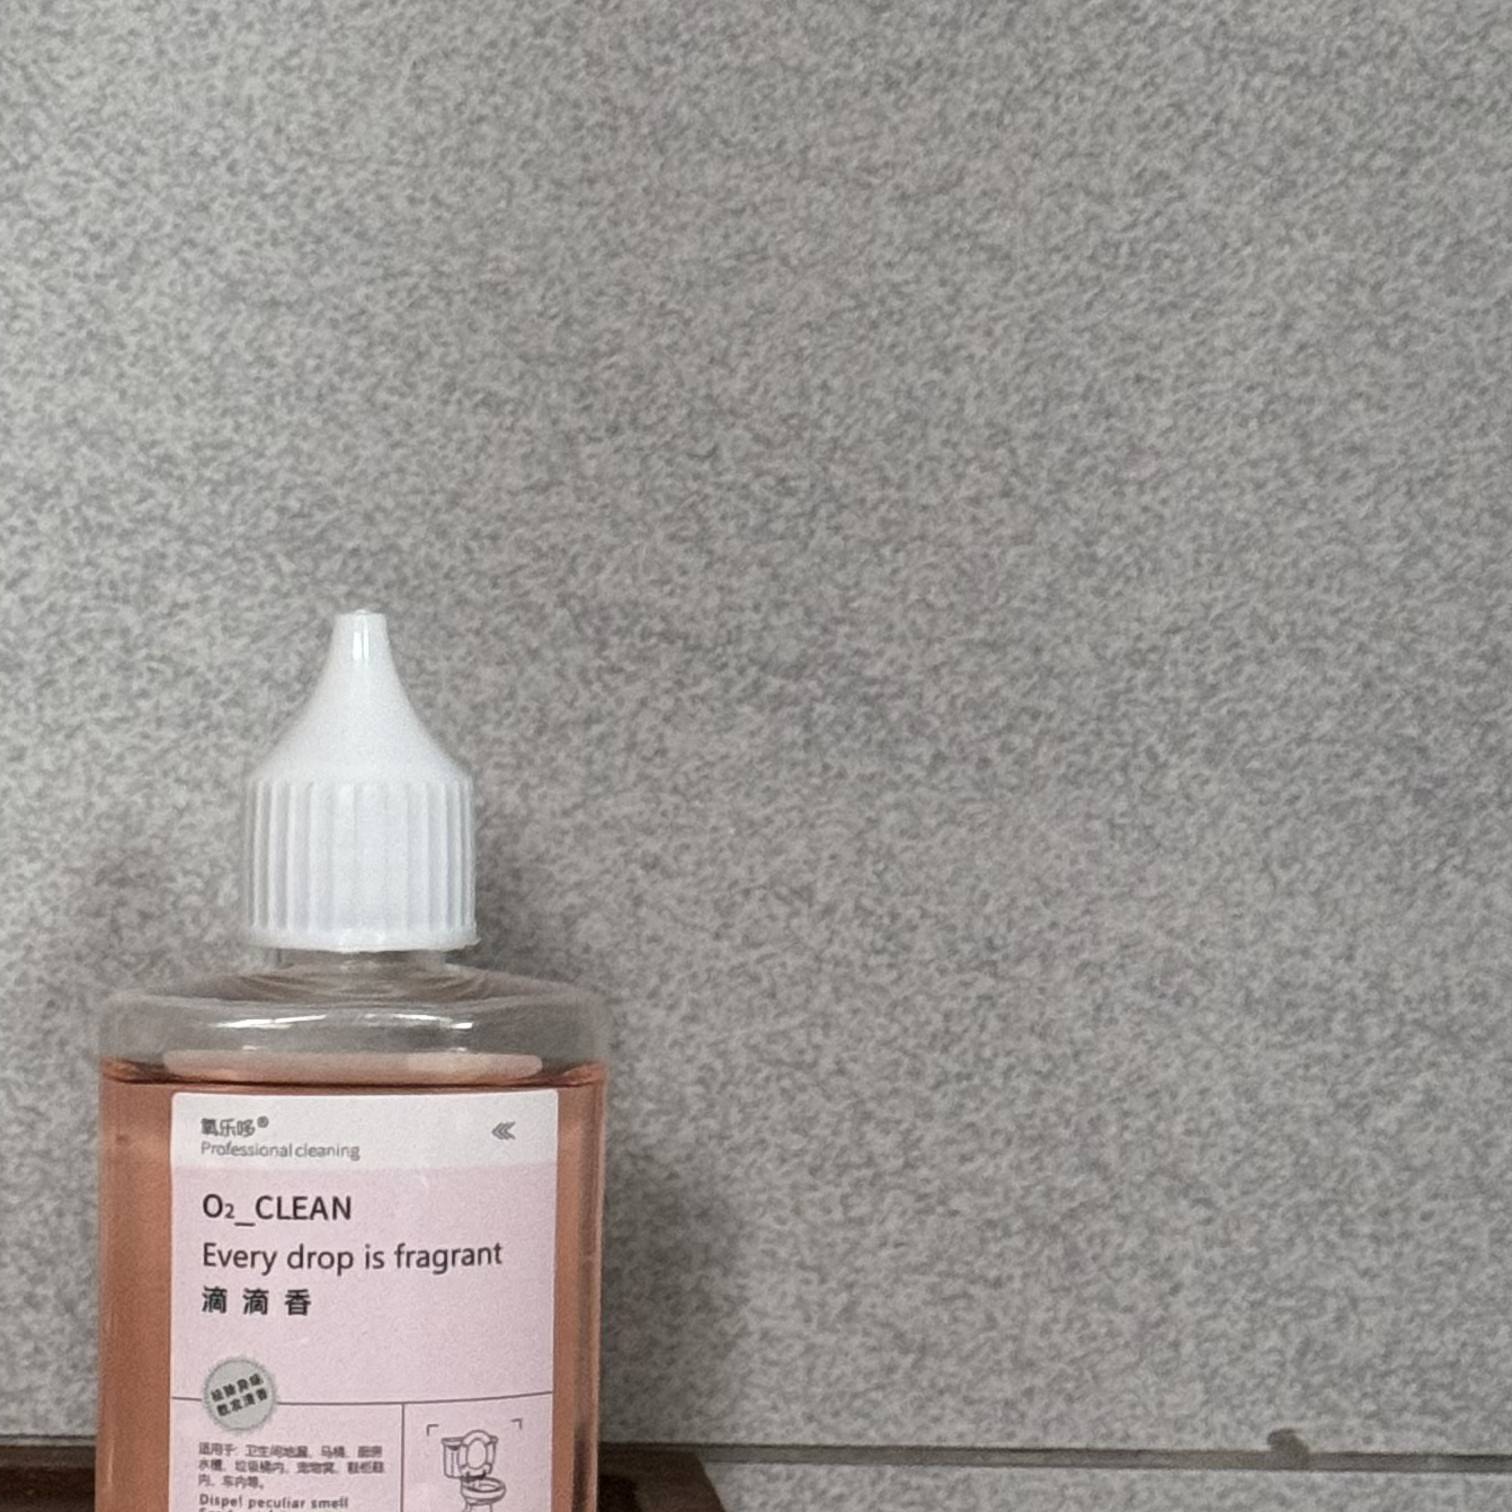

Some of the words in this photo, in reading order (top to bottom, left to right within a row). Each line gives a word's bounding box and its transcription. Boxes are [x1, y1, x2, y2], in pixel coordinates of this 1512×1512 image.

[201, 1140, 293, 1157] Professional
[295, 1143, 361, 1161] cleaning
[202, 1242, 278, 1276] Every
[287, 1244, 354, 1276] drop
[365, 1244, 386, 1270] is
[394, 1242, 503, 1275] fragrant
[199, 1494, 243, 1510] Dispel
[248, 1497, 306, 1510] peculiar
[311, 1497, 349, 1509] smell
